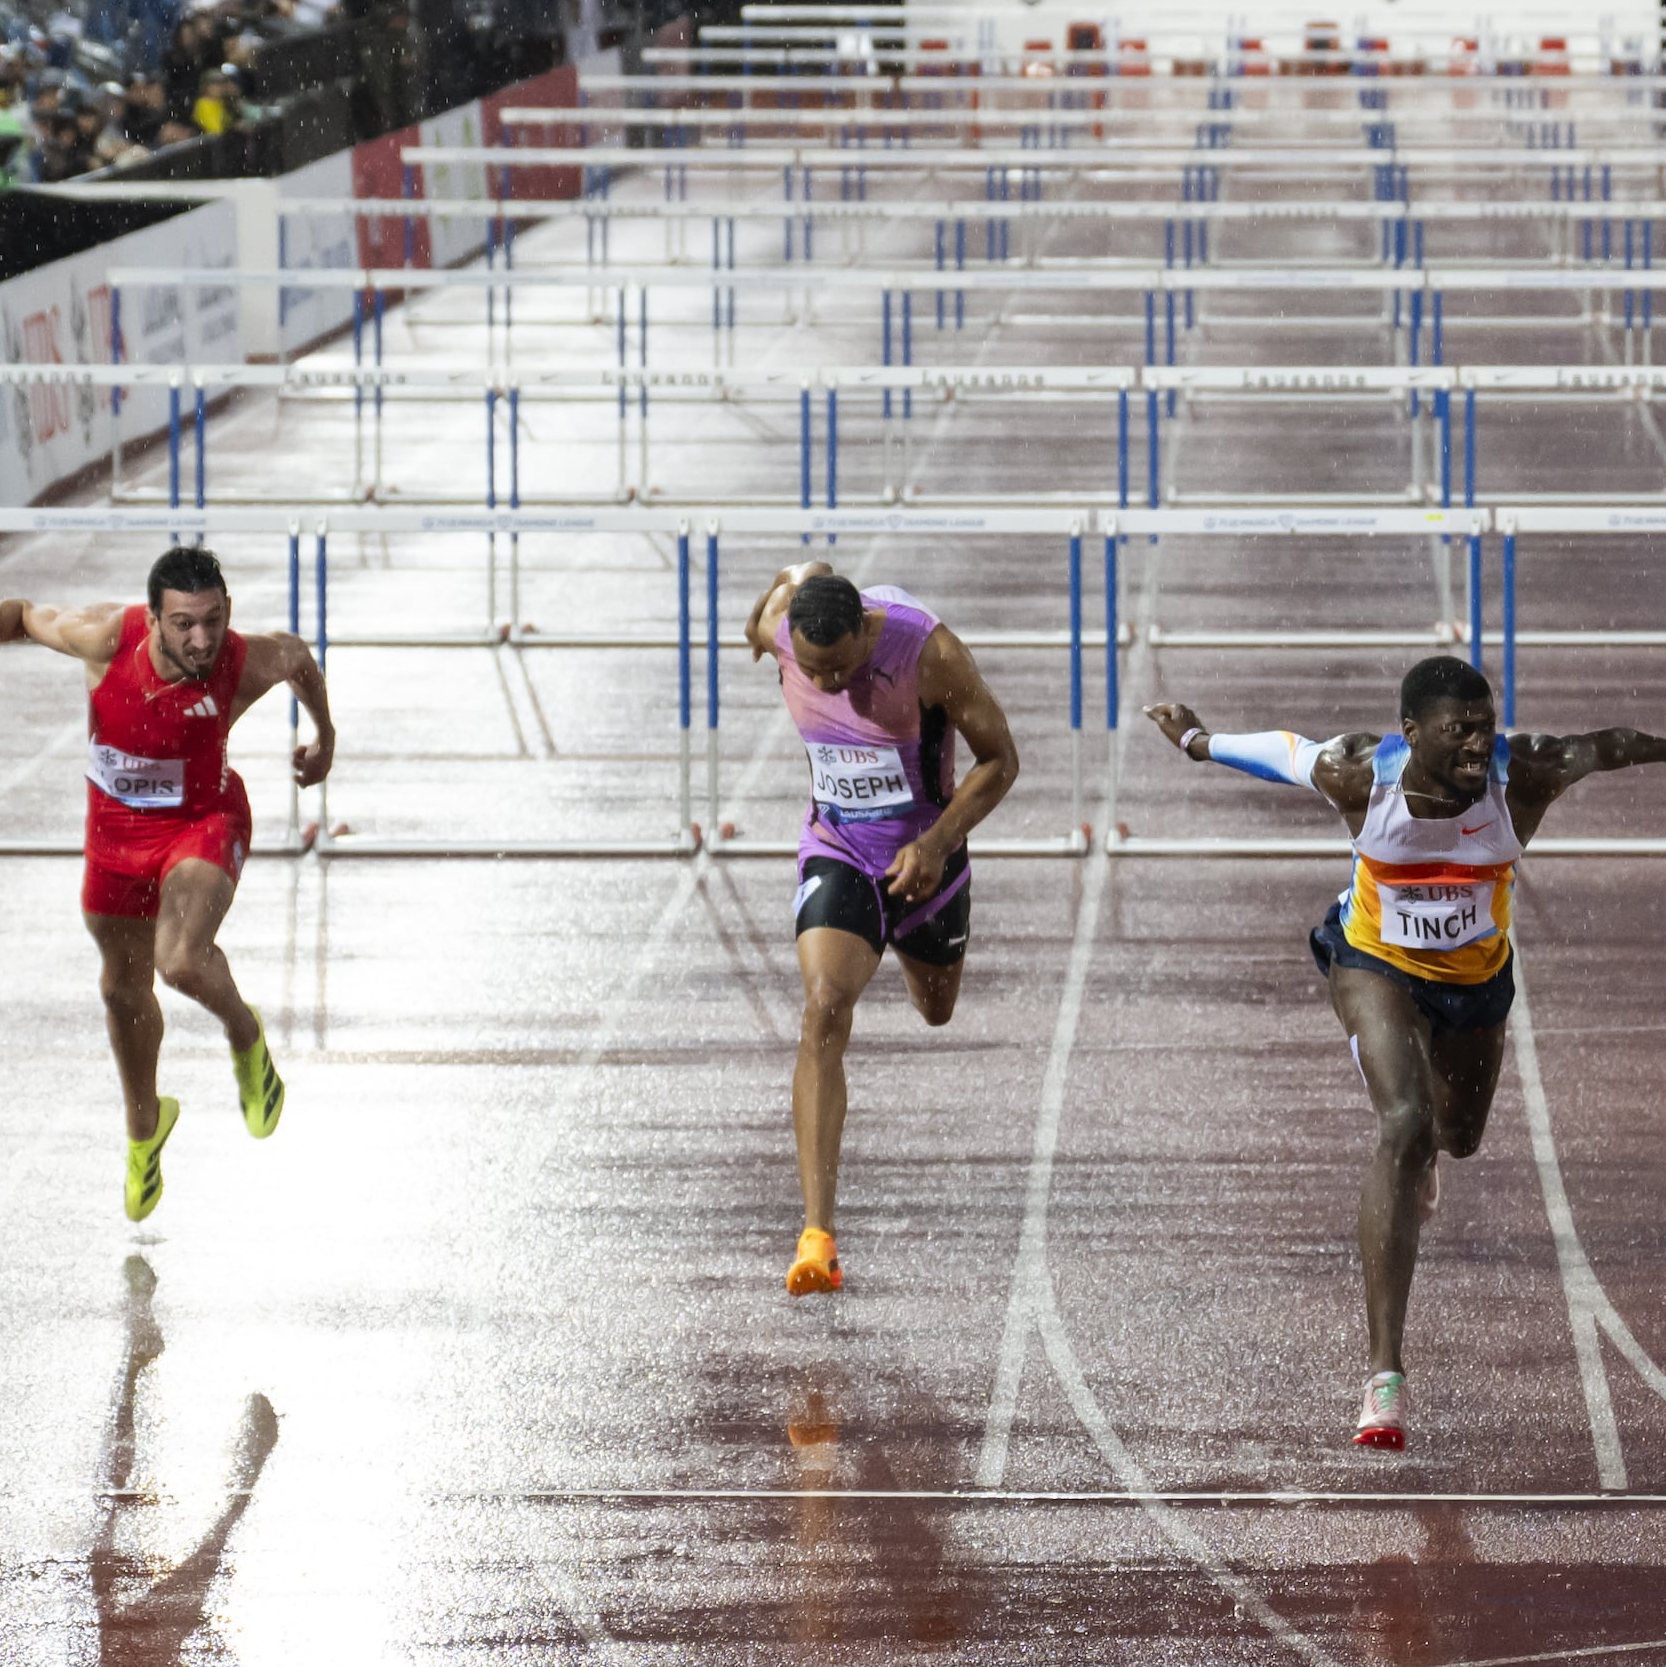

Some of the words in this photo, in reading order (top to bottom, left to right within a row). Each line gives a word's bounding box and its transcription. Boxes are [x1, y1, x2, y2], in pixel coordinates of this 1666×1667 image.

[840, 749, 879, 764] UBS
[817, 770, 903, 799] JOSEPH
[1428, 885, 1474, 902] UBS
[1396, 905, 1477, 940] TINCH
